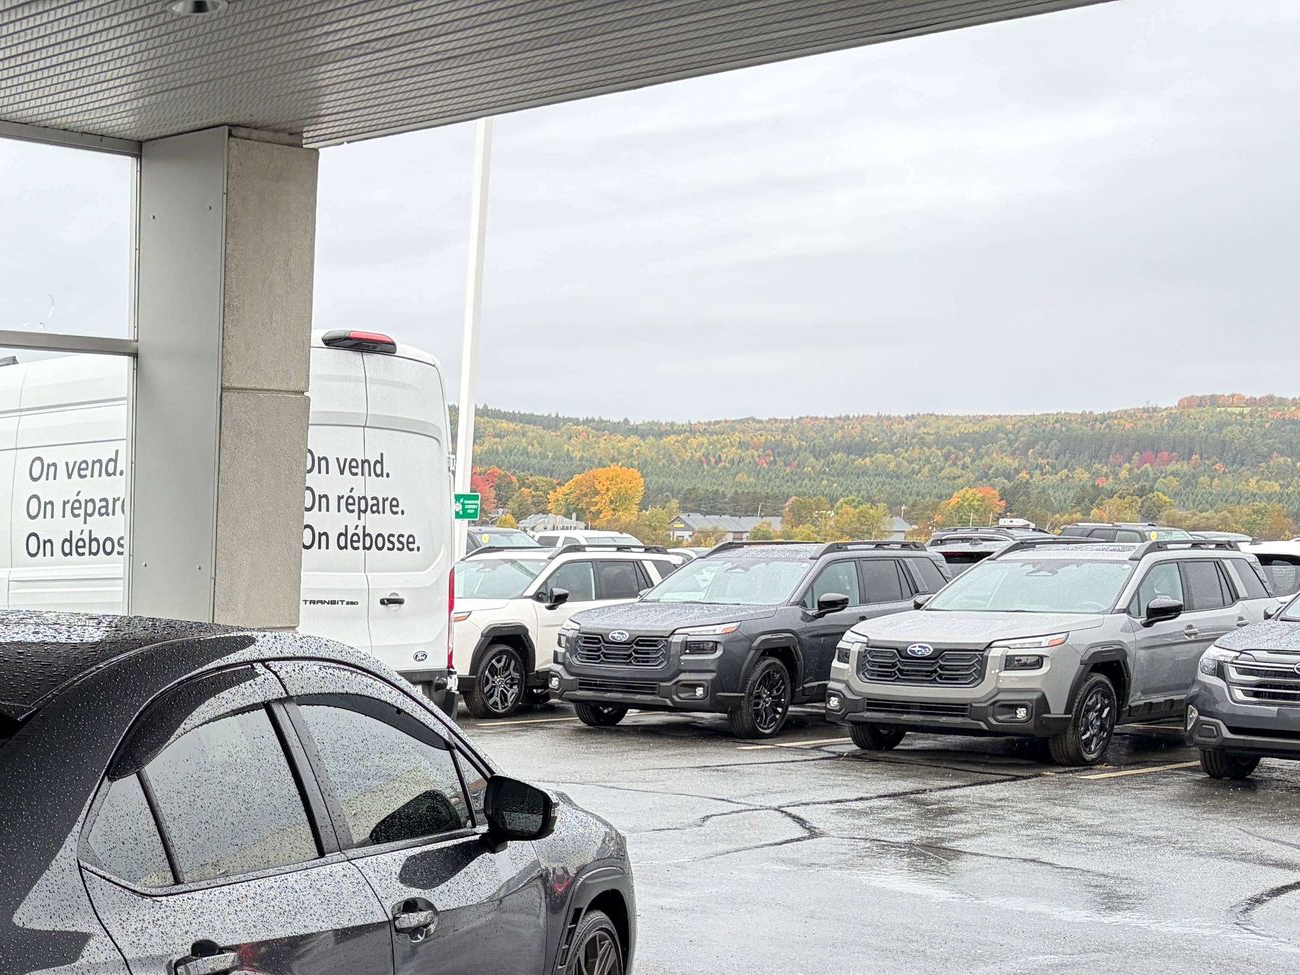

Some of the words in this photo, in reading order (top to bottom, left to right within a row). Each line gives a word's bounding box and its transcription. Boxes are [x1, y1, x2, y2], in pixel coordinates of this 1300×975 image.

[29, 456, 57, 482] On
[65, 449, 124, 479] vend.
[335, 452, 390, 478] vend.
[26, 494, 54, 520] On
[337, 487, 404, 521] répare.
[25, 532, 54, 558] On
[61, 529, 124, 557] débos
[302, 524, 329, 550] On
[336, 525, 420, 552] débosse.
